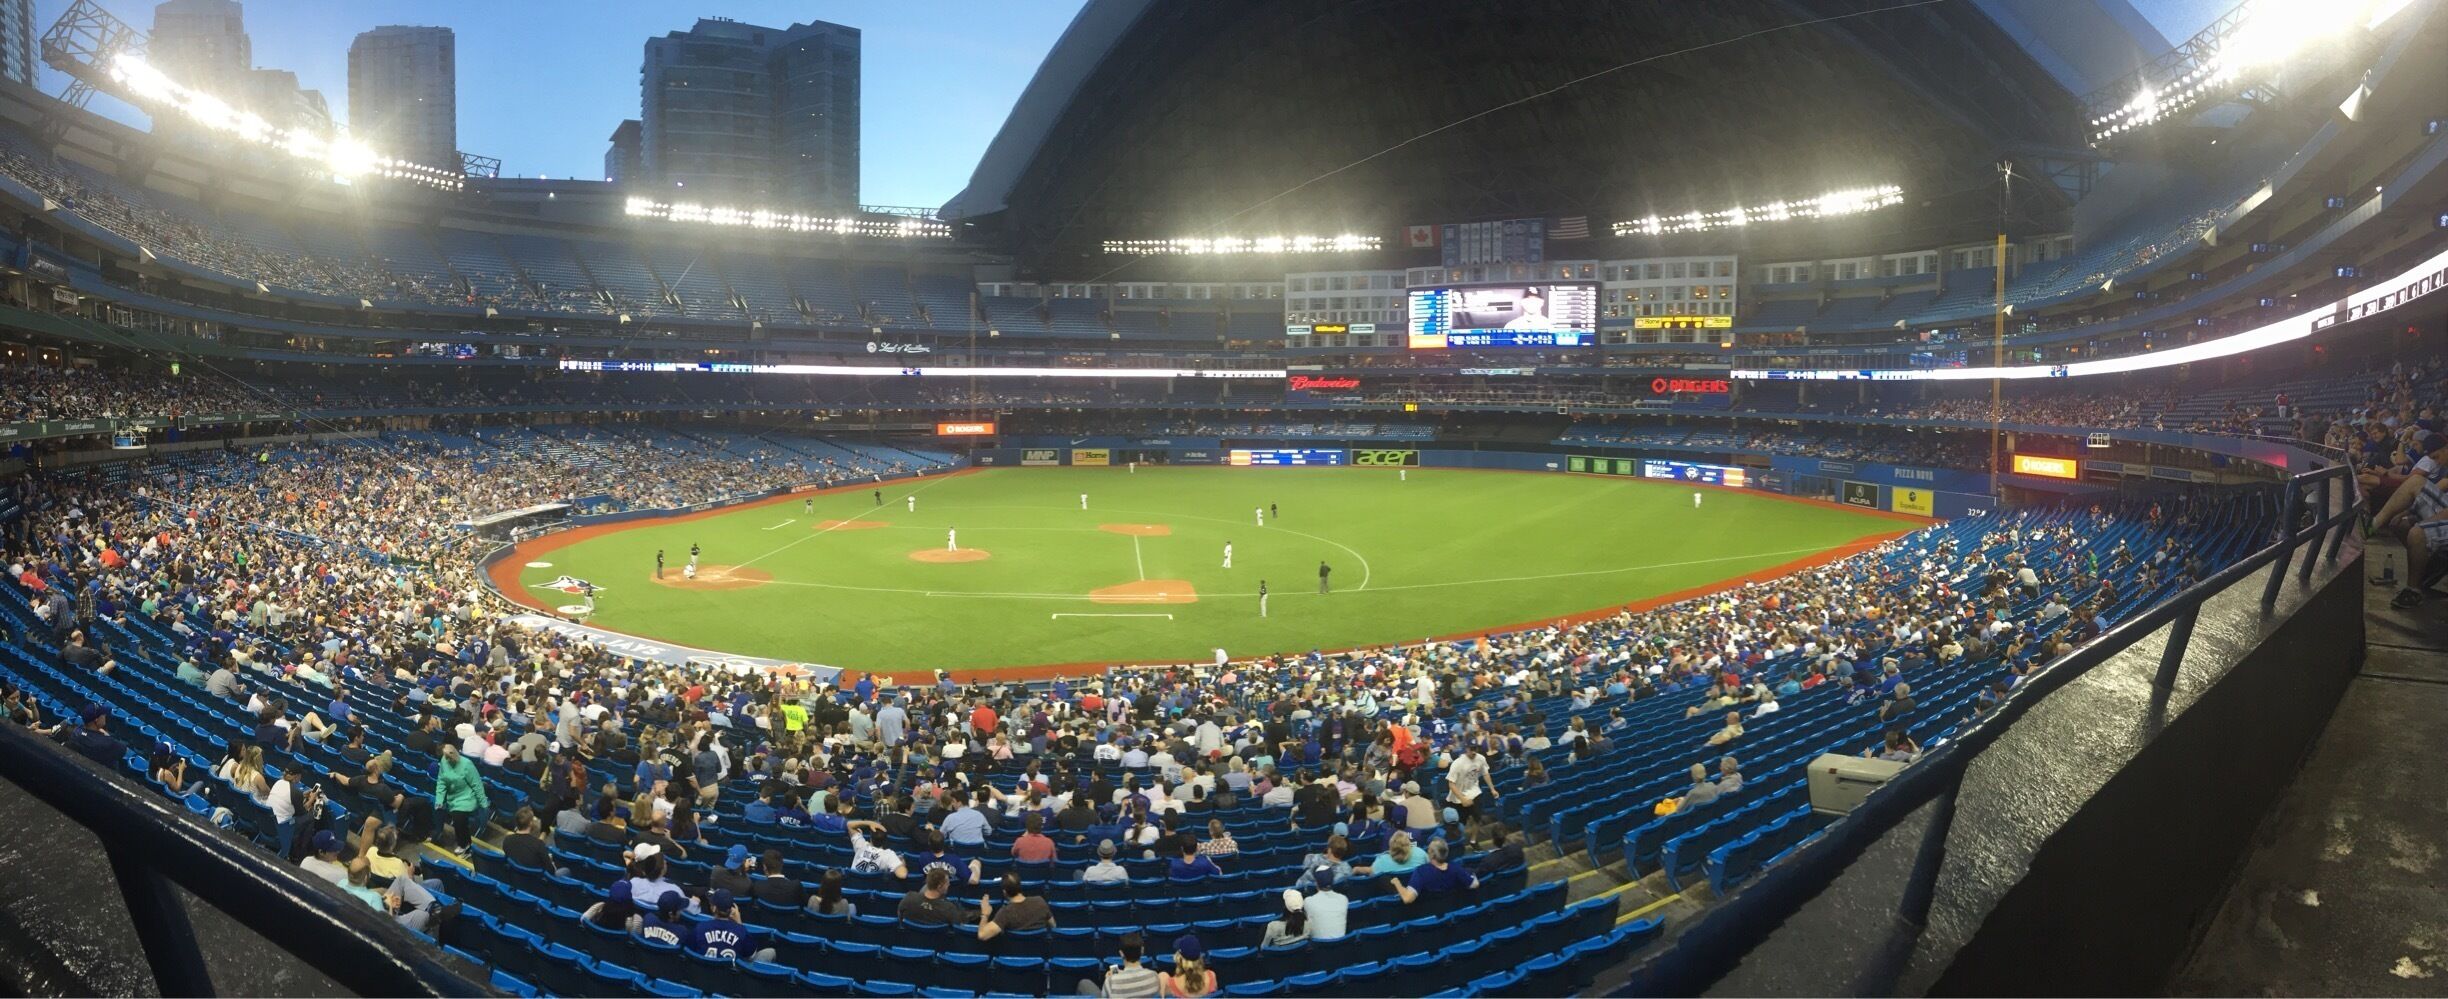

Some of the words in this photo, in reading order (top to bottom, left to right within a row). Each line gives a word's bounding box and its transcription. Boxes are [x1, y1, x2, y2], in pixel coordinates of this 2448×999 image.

[1289, 376, 1360, 389] Budweiser
[1669, 380, 1729, 393] ROGERS
[1026, 451, 1055, 460] MNP
[1357, 450, 1414, 465] acer
[1894, 468, 1914, 479] PIZZA
[1849, 496, 1871, 505] ACURA
[705, 930, 739, 946] DICKEY
